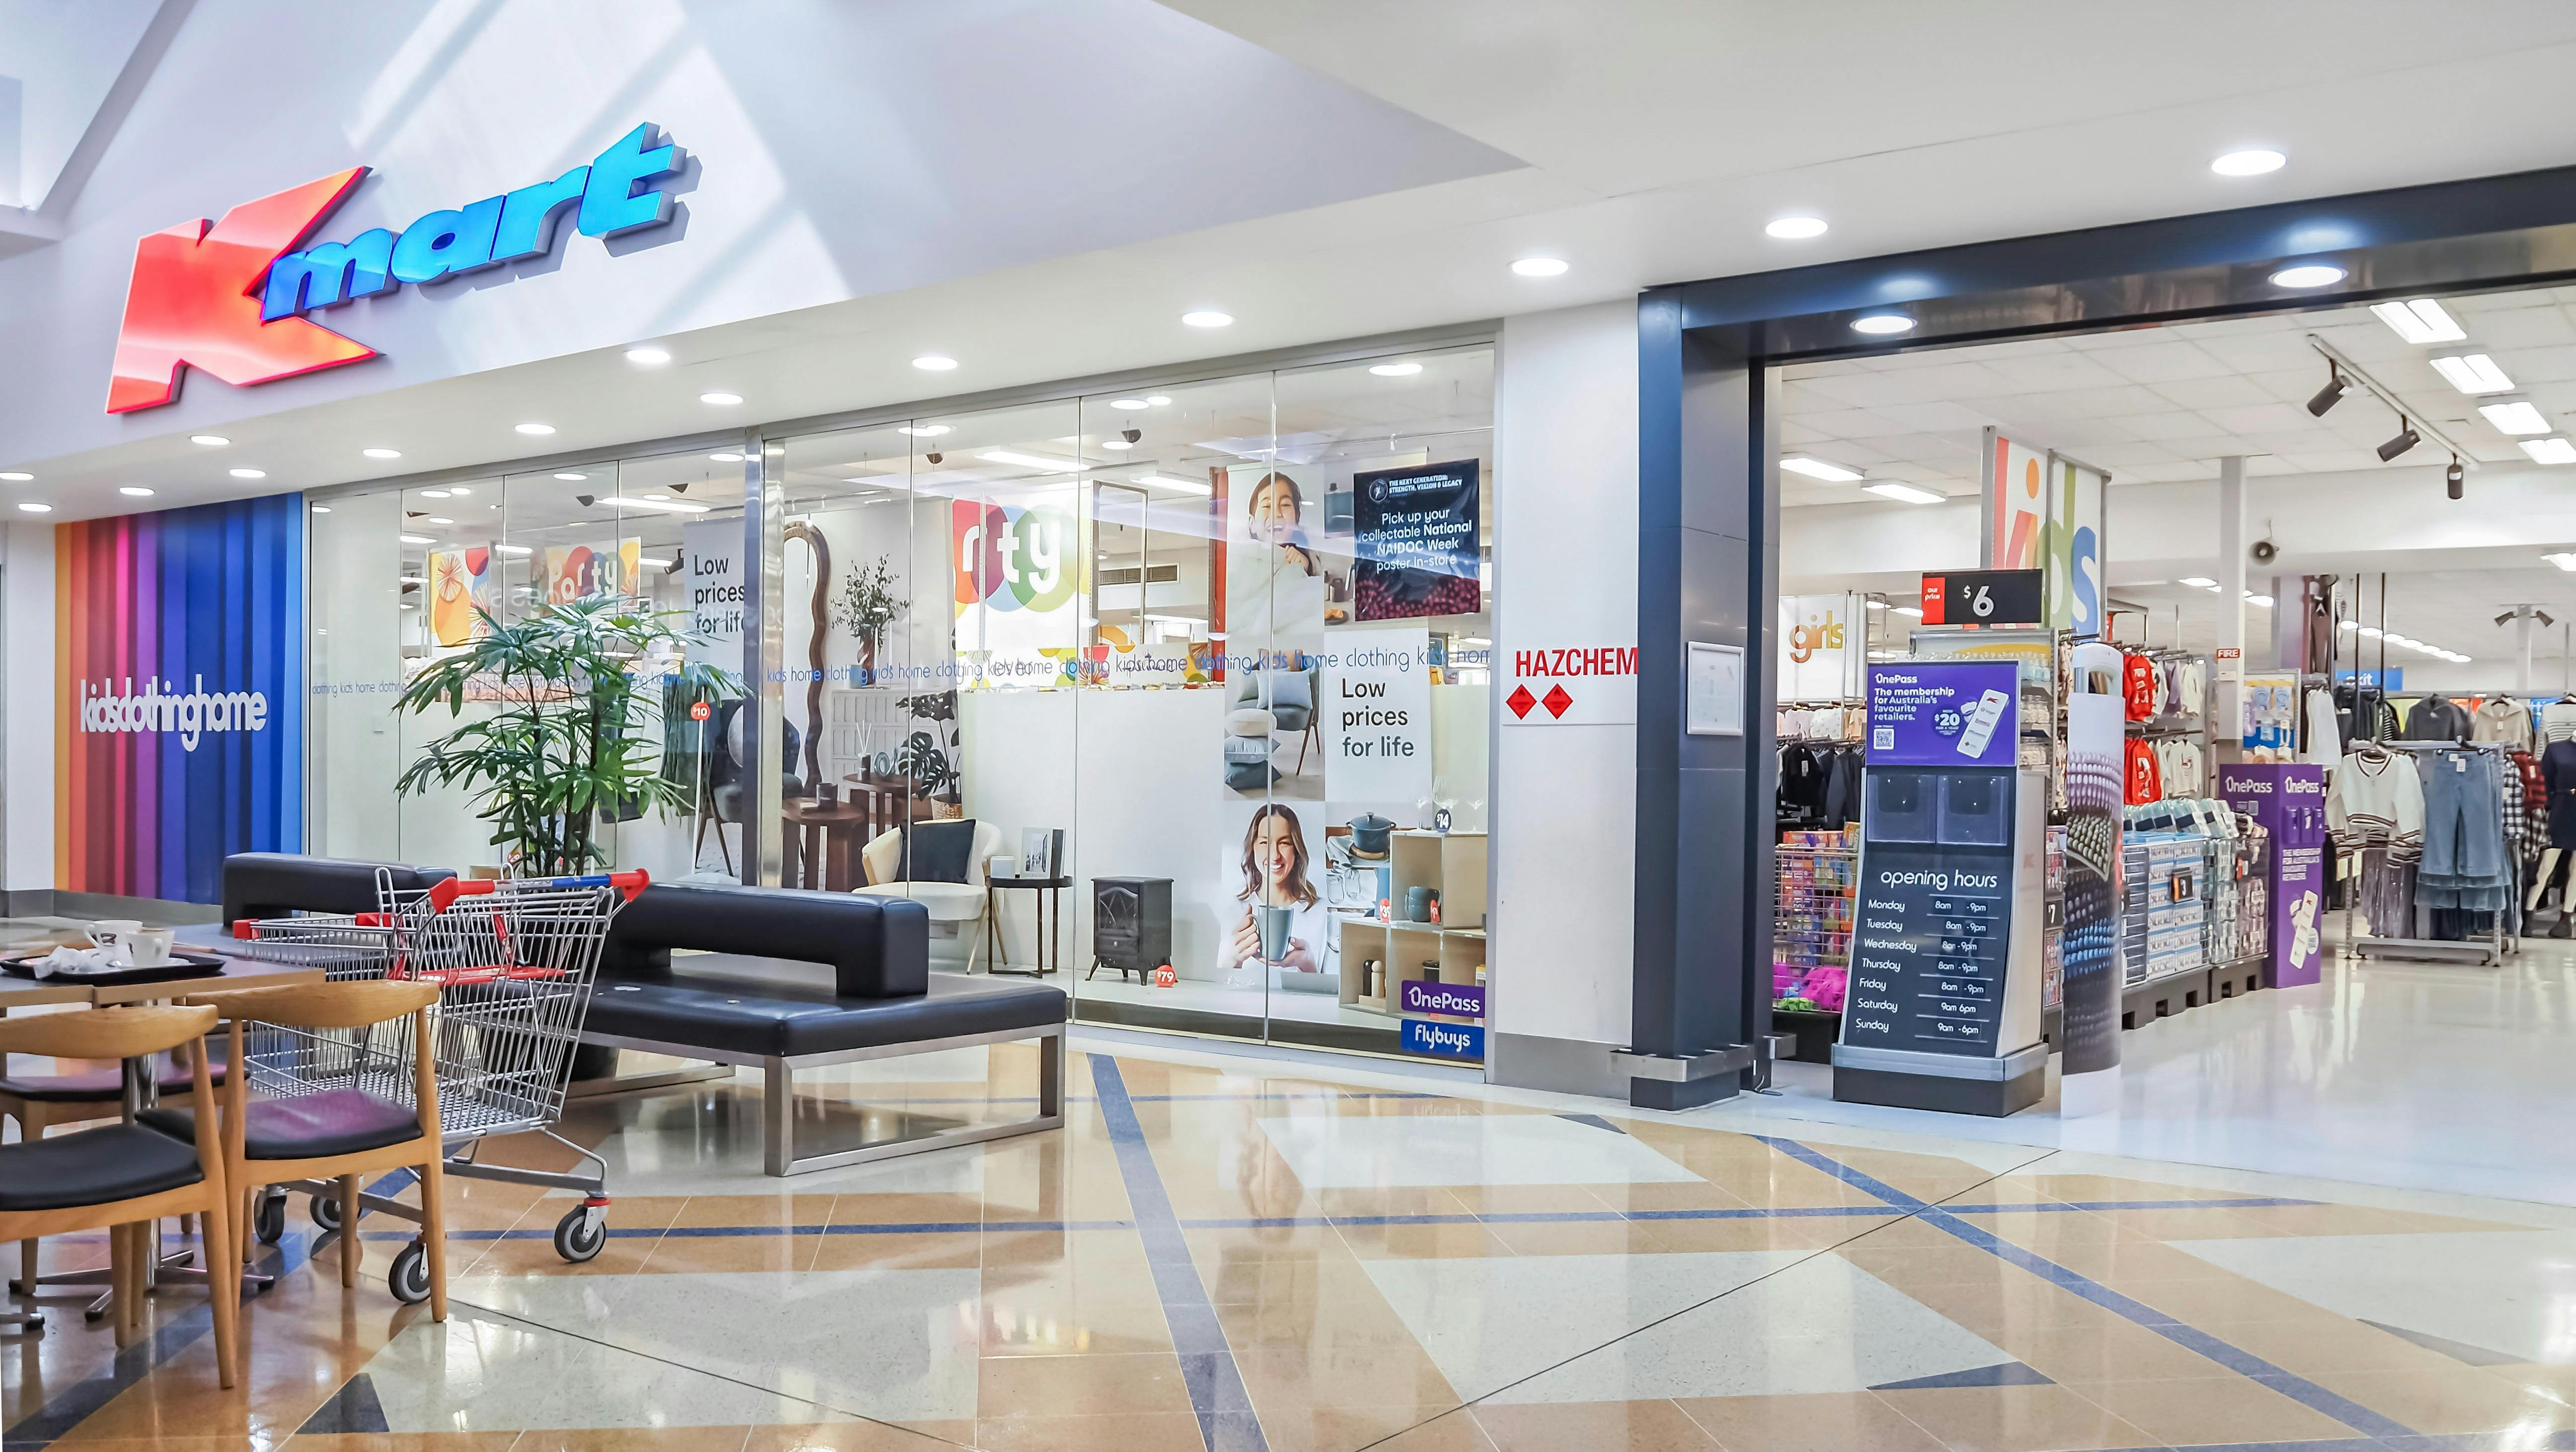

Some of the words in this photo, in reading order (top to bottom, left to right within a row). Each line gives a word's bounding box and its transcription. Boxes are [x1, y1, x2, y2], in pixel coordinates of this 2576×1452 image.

[106, 121, 683, 414] Kmart
[1382, 511, 1404, 525] Pick
[1407, 513, 1421, 524] up
[1424, 509, 1450, 523] your
[1362, 526, 1420, 542] collectable
[1424, 519, 1472, 536] National
[1377, 540, 1424, 555] NAIDOC
[1427, 537, 1459, 551] Week
[695, 554, 729, 576] Low
[1377, 558, 1410, 574] poster
[1414, 554, 1457, 567] in-store
[695, 581, 745, 610] prices
[1924, 593, 1940, 602] price
[695, 612, 719, 633] for
[725, 611, 745, 633] lif
[1789, 610, 1844, 663] girls
[767, 666, 787, 683] kids
[791, 666, 822, 682] home
[825, 664, 868, 686] clothing
[872, 662, 894, 680] kids
[898, 662, 930, 679] home
[936, 659, 982, 682] clothing
[1059, 656, 1110, 678] clothing
[1196, 651, 1252, 675] clothing
[1258, 649, 1288, 670] kids
[1294, 648, 1338, 669] home
[1346, 647, 1409, 672] clothing
[1417, 645, 1448, 666] kids
[1457, 644, 1490, 664] hom
[1515, 647, 1638, 677] HAZCHEM
[1875, 673, 1918, 684] OnePass
[312, 680, 338, 697] clothing
[340, 680, 353, 693] kids
[355, 679, 375, 693] home
[1342, 678, 1386, 698] Low
[1874, 687, 1892, 695] The
[1894, 686, 1955, 697] membership
[693, 706, 708, 717] $10
[1874, 704, 1917, 712] favourite
[1874, 712, 1916, 720] retailers.
[1342, 706, 1408, 737] prices
[1934, 713, 1960, 726] $20
[1342, 737, 1375, 758] for
[1380, 736, 1414, 757] life
[2226, 775, 2273, 793] OnePass
[2285, 775, 2319, 793] OnePass
[1436, 813, 1449, 829] $14
[1880, 870, 1948, 890] opening
[1953, 869, 1998, 889] hours
[1868, 899, 1905, 913] Monday
[1935, 901, 1951, 910] 8am
[1867, 918, 1903, 933] Tuesday
[1946, 921, 1962, 930] 8am
[1864, 938, 1917, 953] Wednesday
[1862, 958, 1901, 972] Thursday
[1938, 962, 1954, 971] 8am
[1157, 970, 1175, 983] $79
[1859, 978, 1887, 992] Friday
[1941, 982, 1957, 992] 8am
[1408, 986, 1480, 1012] OnePass
[1857, 998, 1898, 1013] Saturday
[1941, 1003, 1957, 1012] 9am
[1959, 1004, 1976, 1015] 6pm
[1856, 1019, 1889, 1033] Sunday
[1938, 1023, 1953, 1033] 9am
